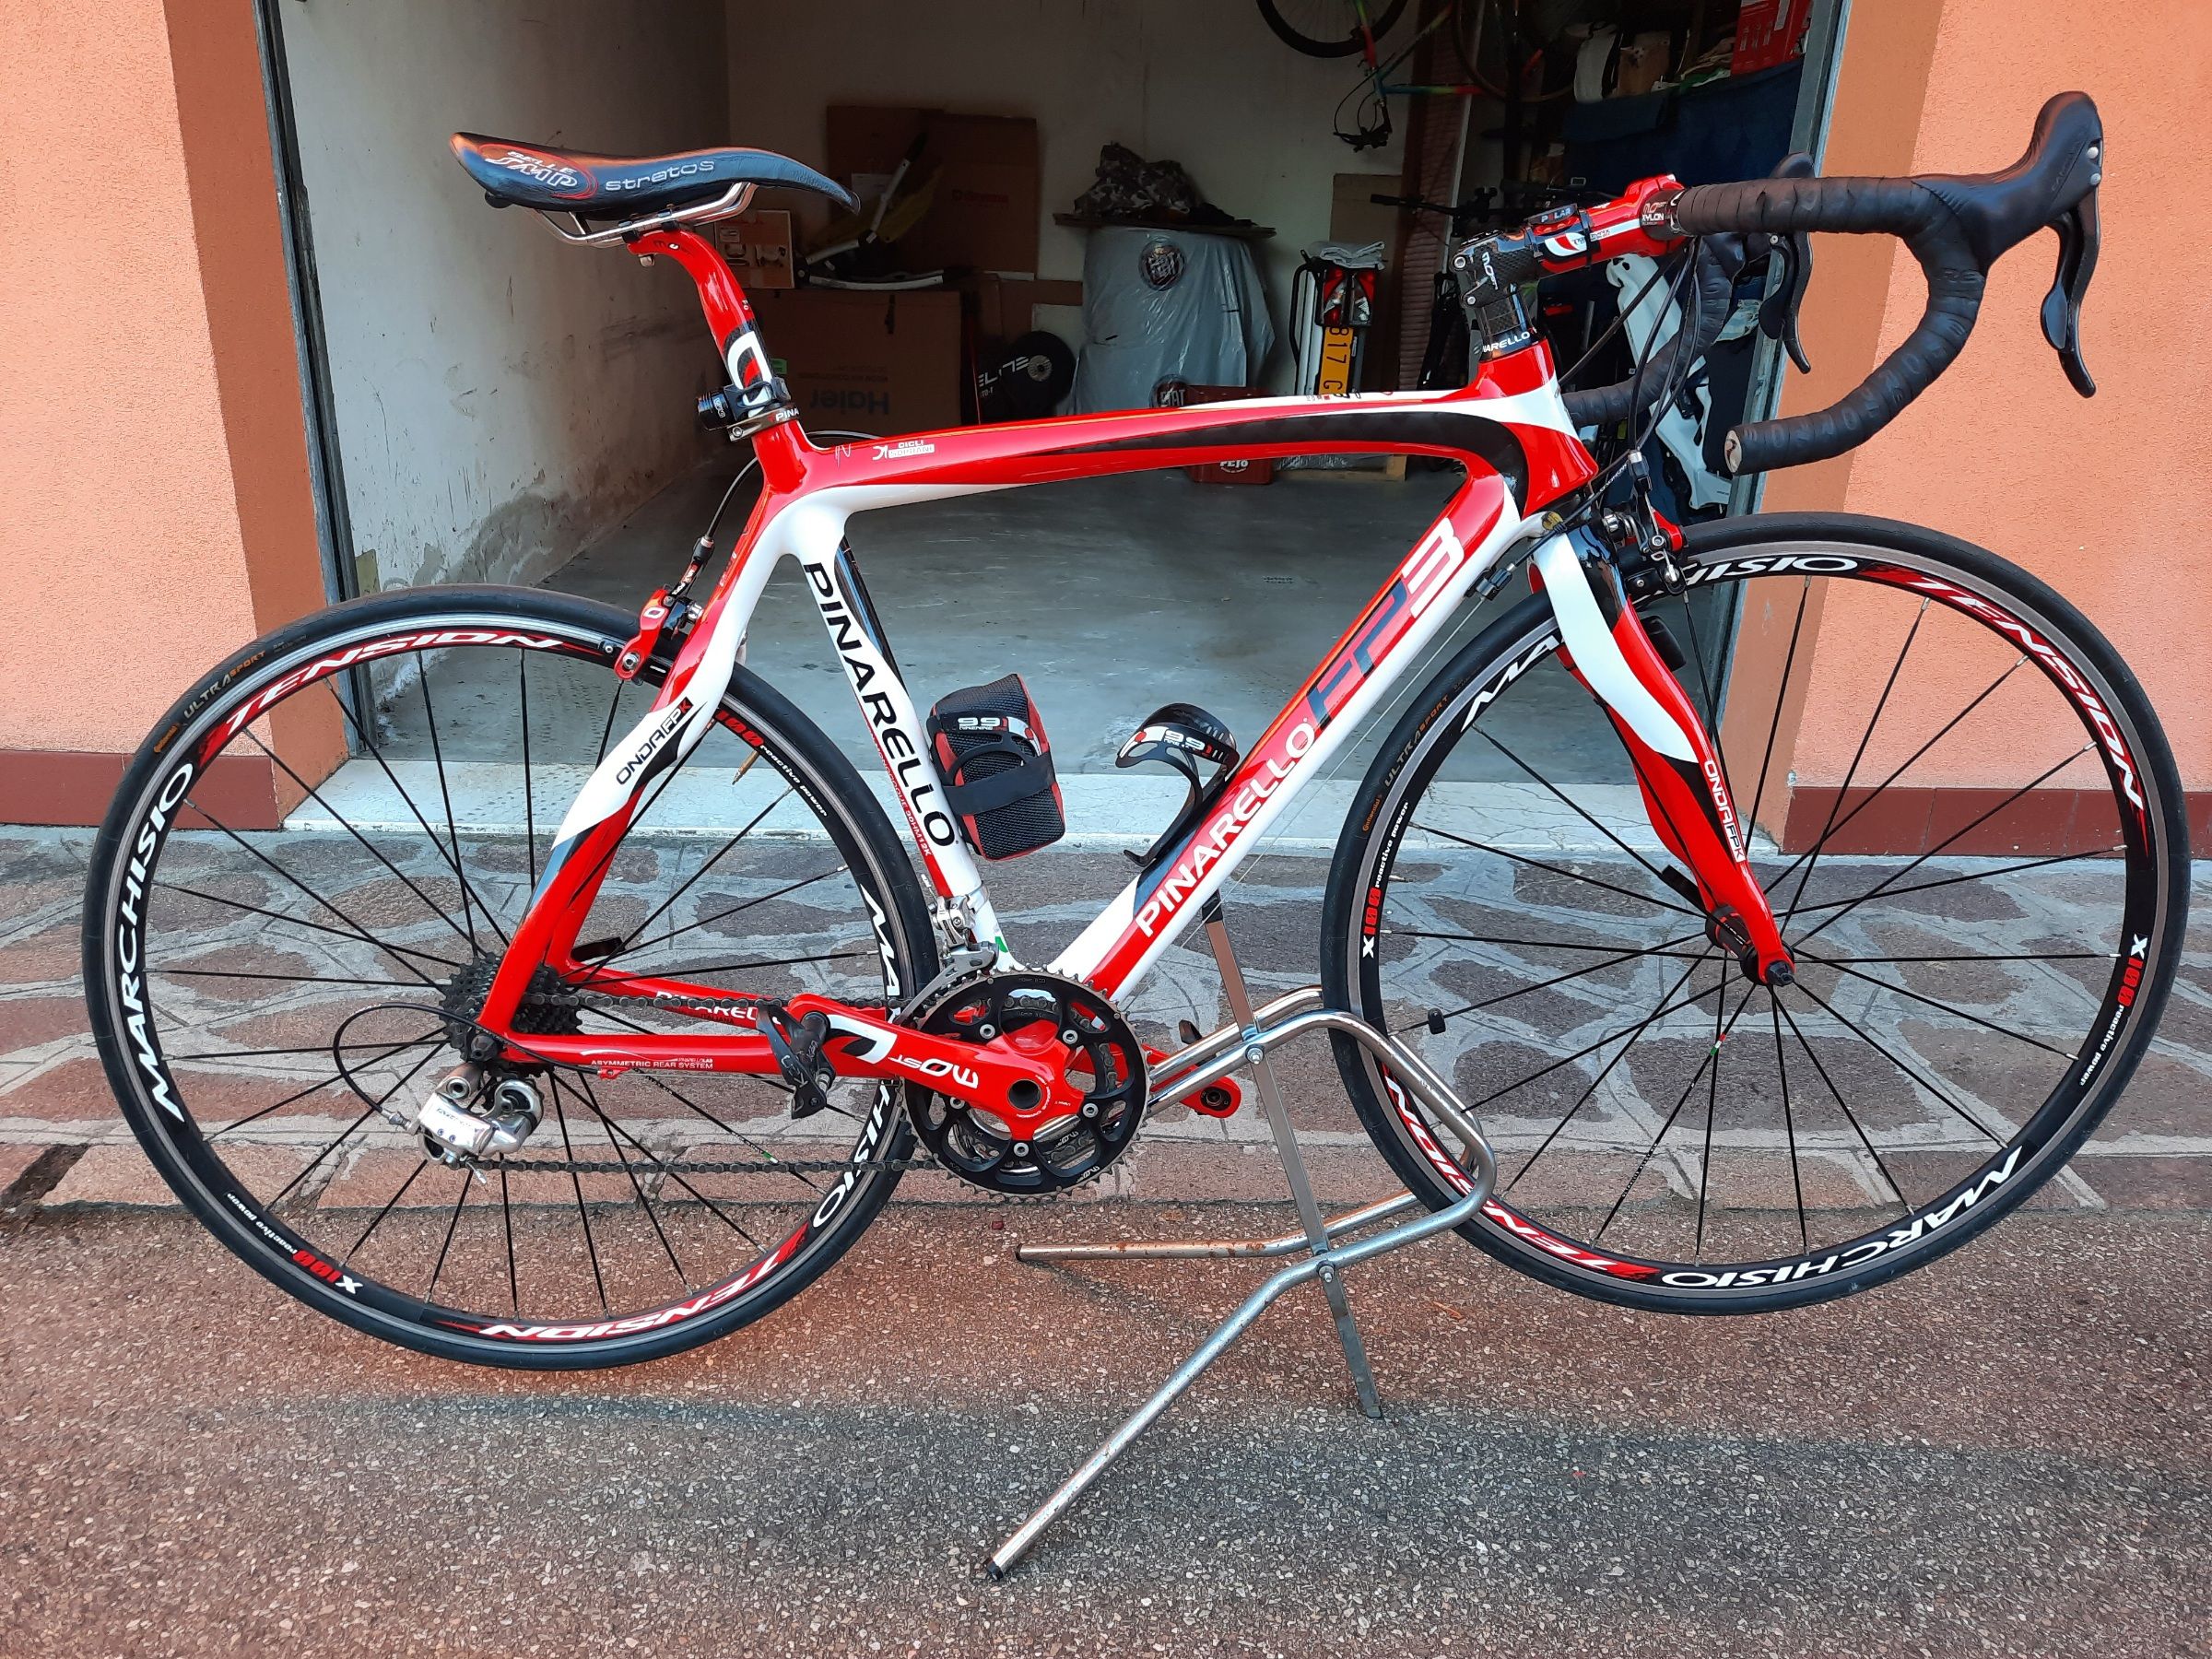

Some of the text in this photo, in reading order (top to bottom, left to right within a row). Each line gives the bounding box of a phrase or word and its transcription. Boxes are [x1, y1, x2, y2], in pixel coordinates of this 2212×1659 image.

[605, 160, 715, 192] stratos
[1540, 207, 1571, 223] POLAR
[809, 389, 890, 415] Haier
[1305, 517, 1465, 728] FP3
[227, 631, 563, 737] TENSION
[805, 561, 957, 847] PINARELLO
[1904, 575, 2146, 810] TENSION
[617, 729, 665, 784] ONDA
[759, 745, 801, 783] reactive
[799, 785, 828, 817] power
[1704, 759, 1734, 824] ONDA
[1135, 721, 1316, 938] PINARELLO
[1375, 840, 1393, 888] reactive
[1391, 802, 1409, 838] power
[120, 762, 194, 1123] MARCHISIO
[2100, 1004, 2124, 1052] reactive
[678, 1062, 713, 1070] SYSTEM
[888, 1053, 979, 1089] MOST
[2079, 1052, 2101, 1087] power
[227, 1193, 258, 1221] power
[255, 1221, 299, 1254] reactive
[1662, 1146, 2022, 1288] MARCHISIO
[479, 1252, 782, 1338] TENSION
